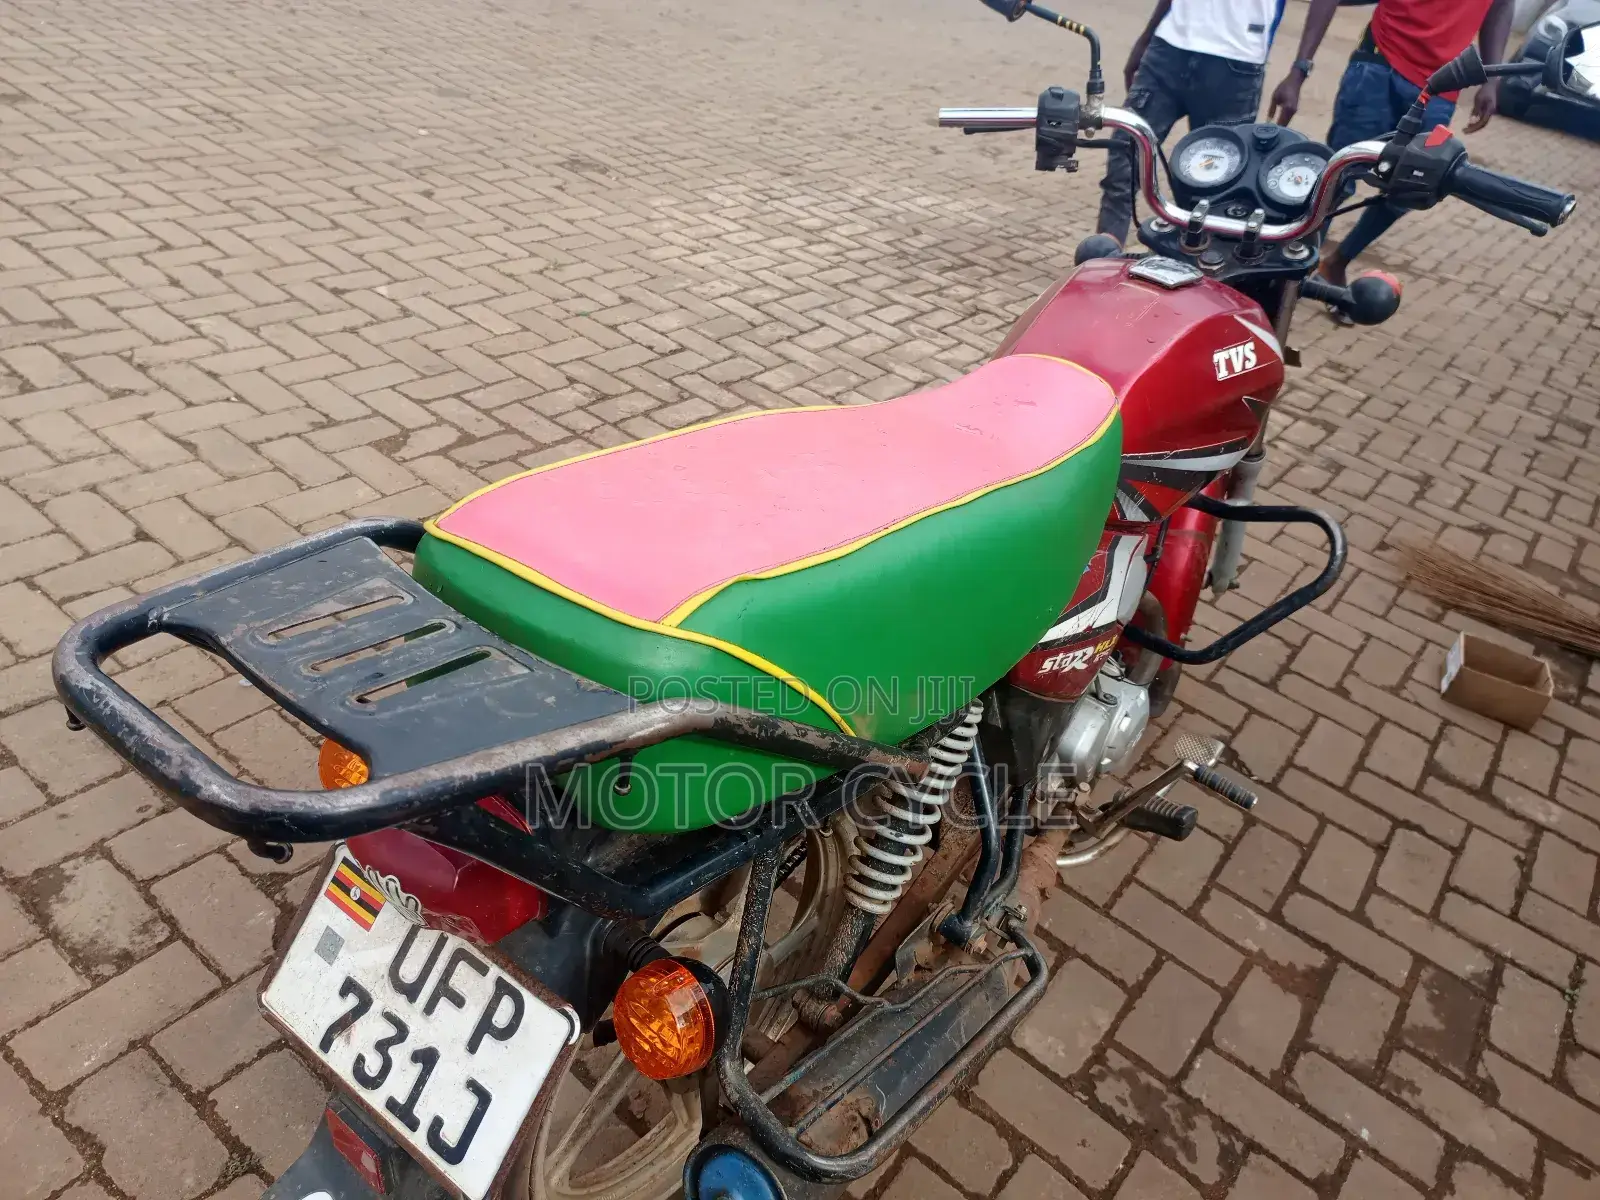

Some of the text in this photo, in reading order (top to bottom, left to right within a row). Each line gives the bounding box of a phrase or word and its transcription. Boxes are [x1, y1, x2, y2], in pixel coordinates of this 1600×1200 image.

[1213, 341, 1257, 379] TVS
[388, 924, 525, 1055] UFP
[319, 975, 493, 1165] 731J
